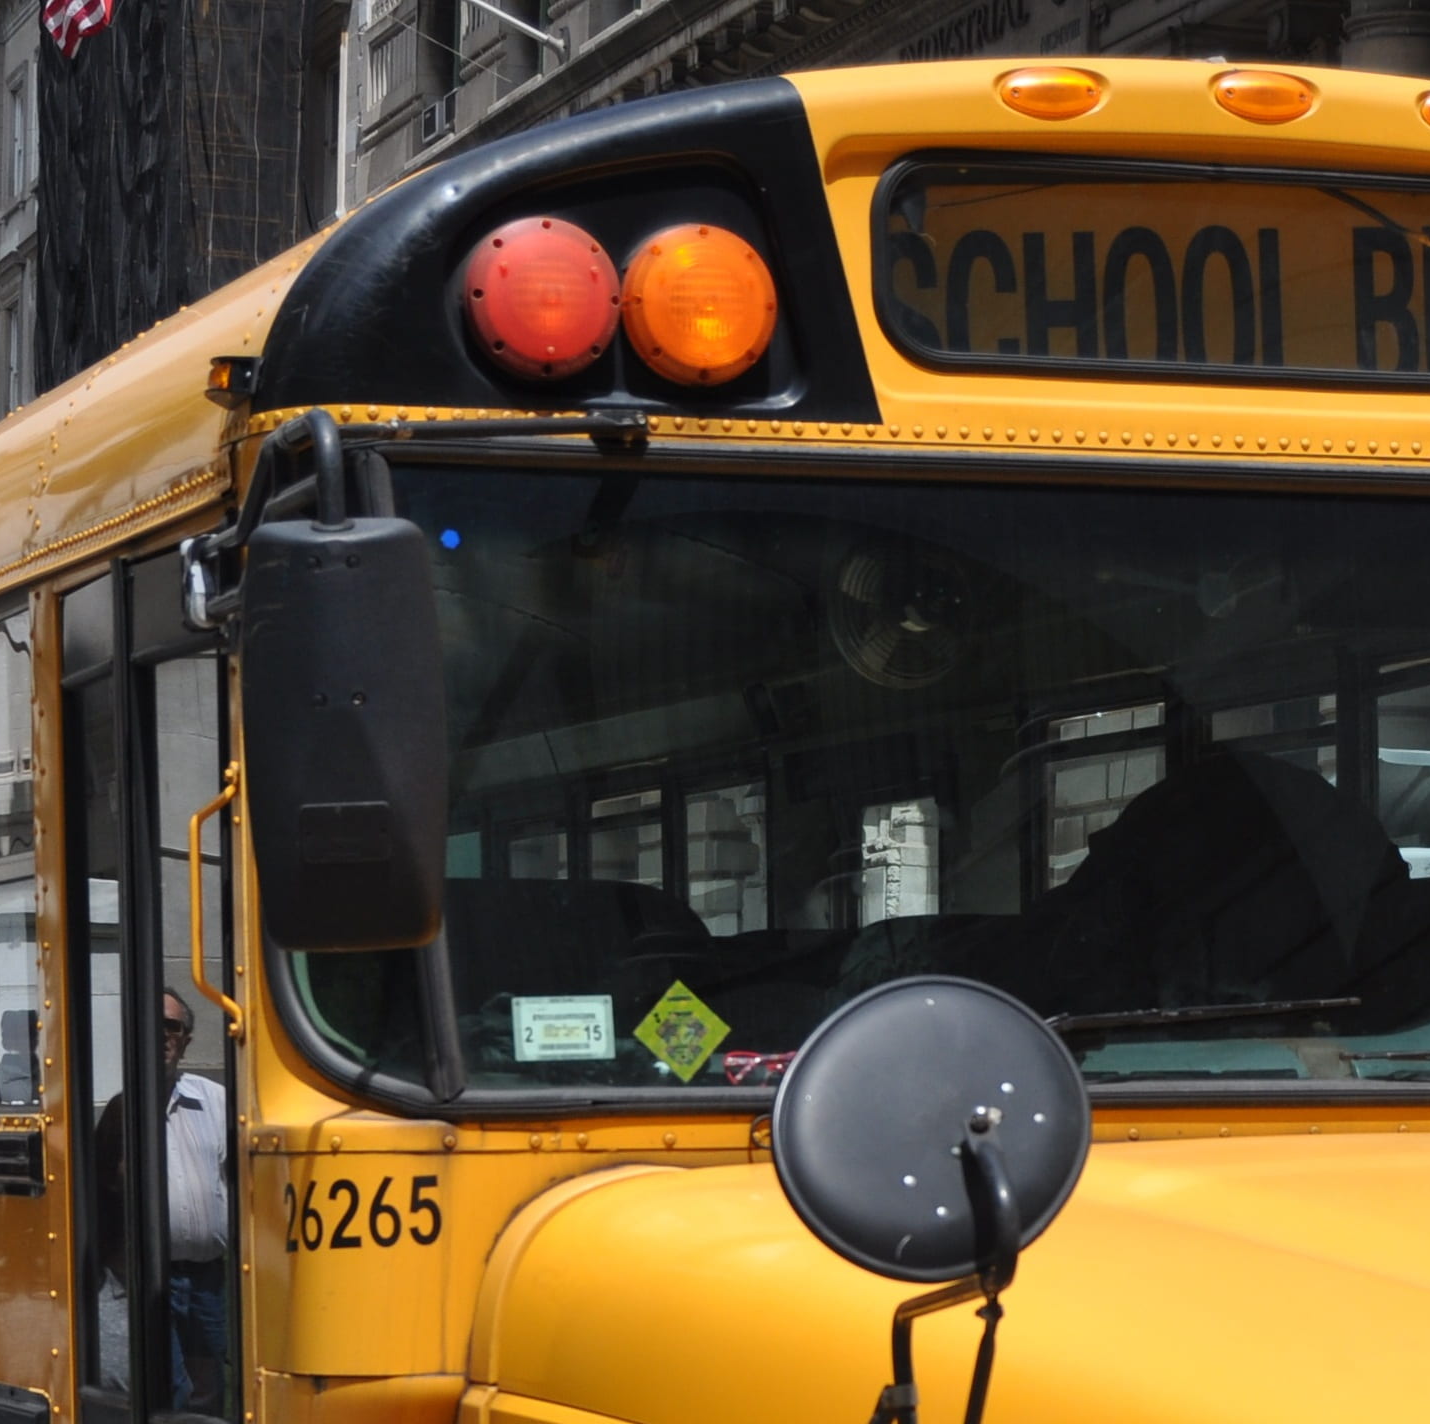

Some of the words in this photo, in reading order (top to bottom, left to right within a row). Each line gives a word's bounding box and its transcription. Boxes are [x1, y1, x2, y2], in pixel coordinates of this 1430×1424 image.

[524, 1026, 534, 1043] 2
[584, 1024, 602, 1041] 15
[283, 1174, 443, 1252] 26265
